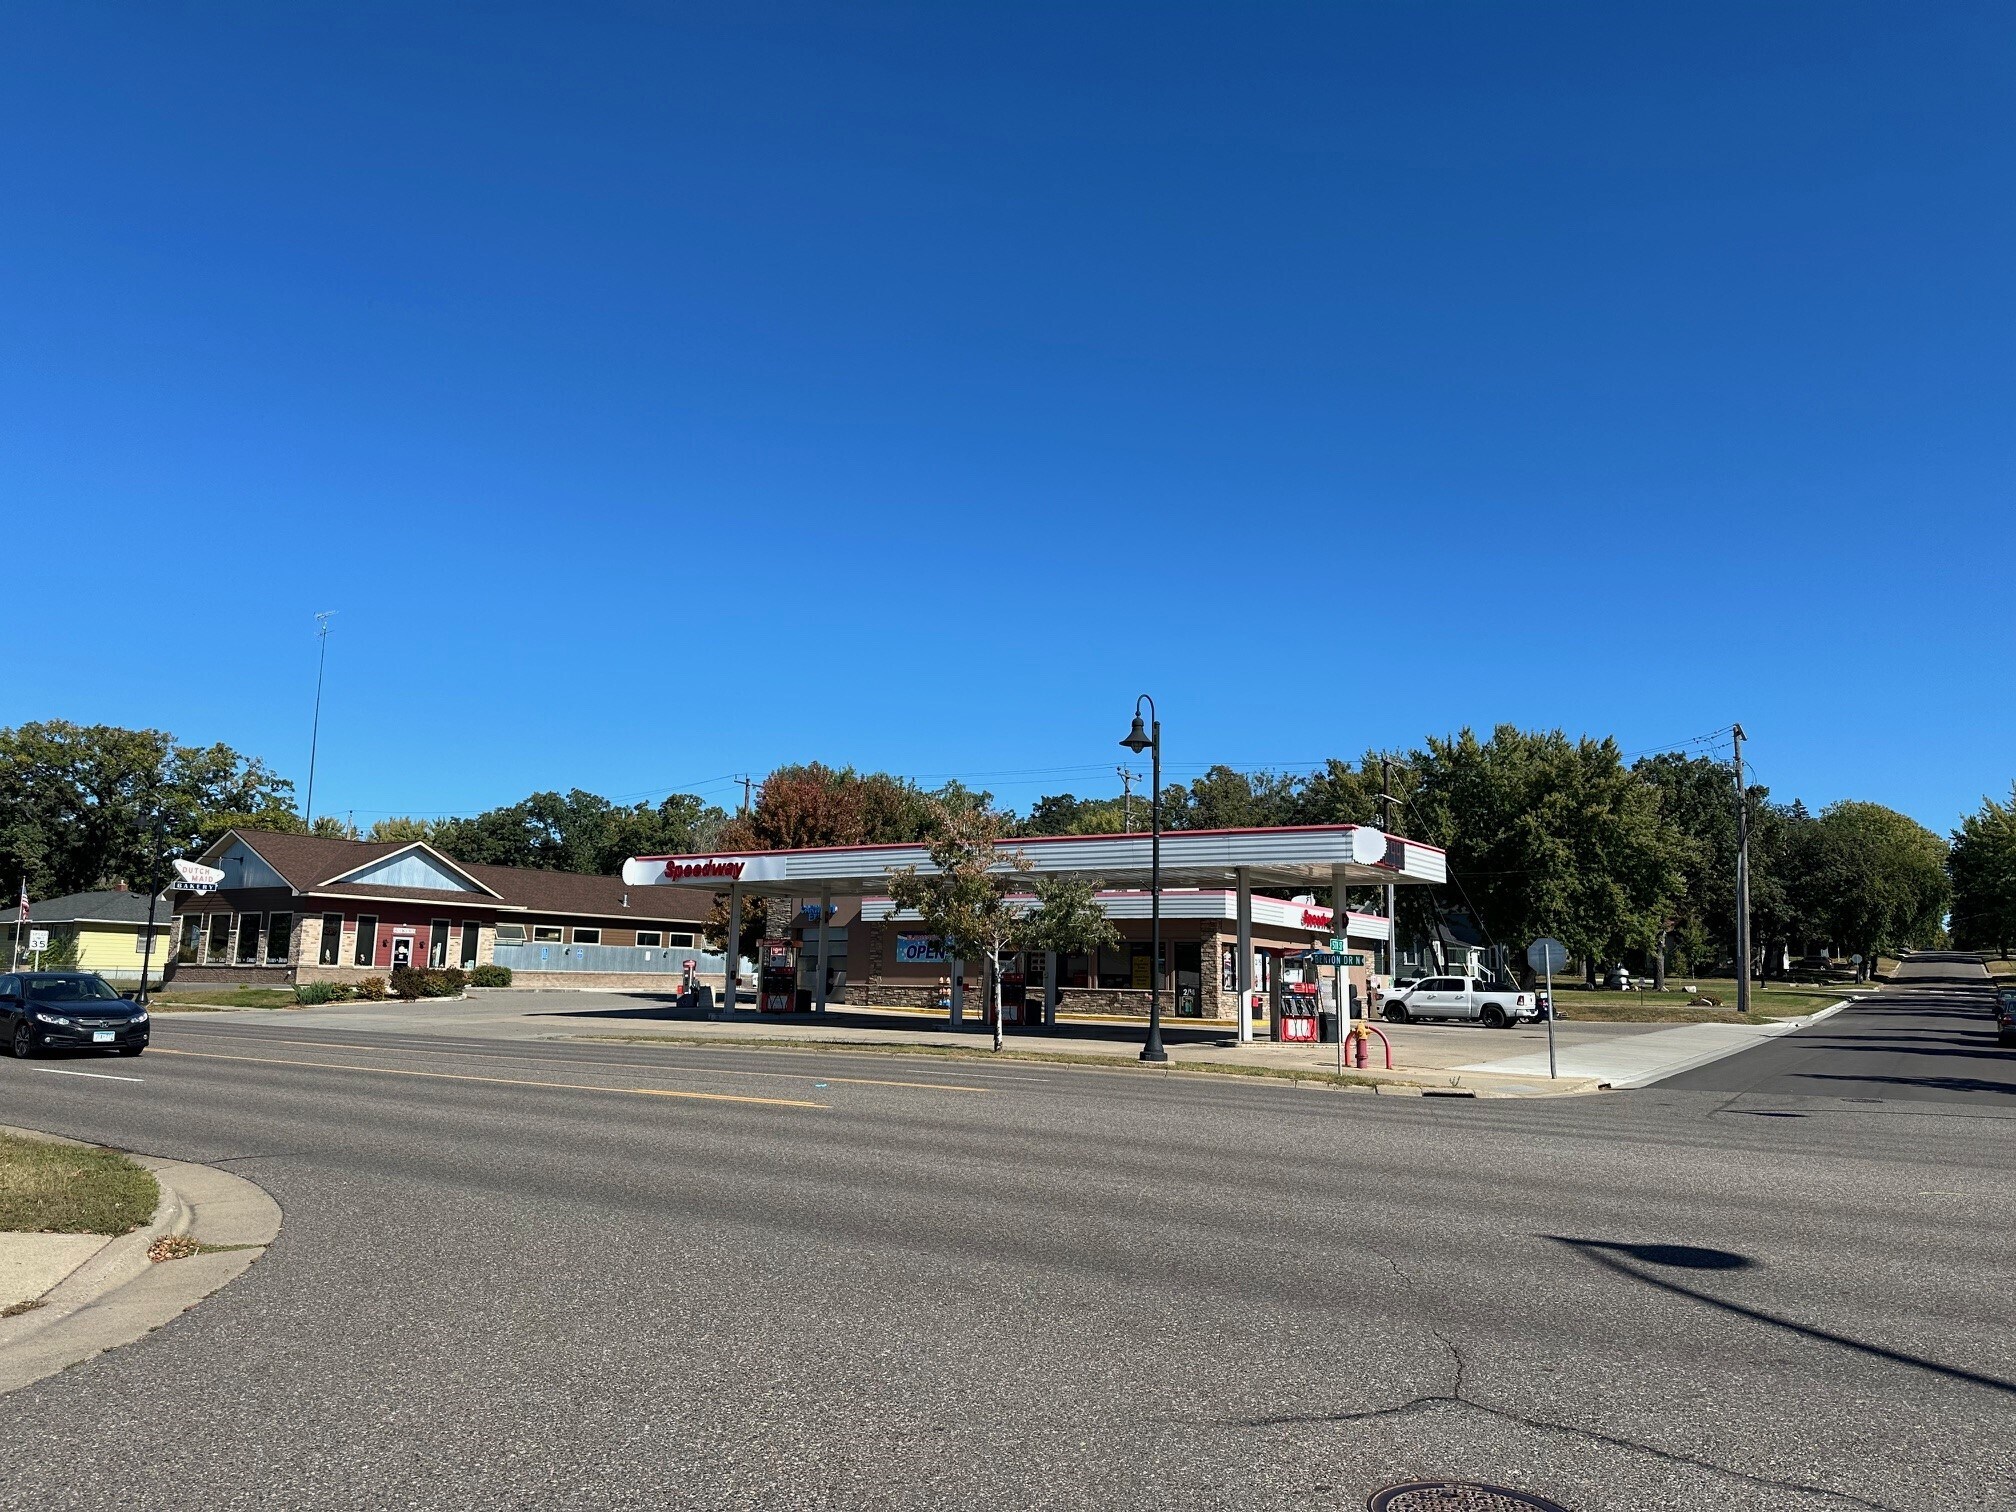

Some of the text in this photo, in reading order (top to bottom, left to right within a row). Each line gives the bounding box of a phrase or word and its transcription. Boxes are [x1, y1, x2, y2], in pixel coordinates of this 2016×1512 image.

[182, 866, 210, 875] DUTCH
[664, 859, 745, 882] Speedway
[31, 940, 46, 948] 35
[906, 944, 946, 960] OPEN
[1314, 955, 1361, 965] BENTON DR N
